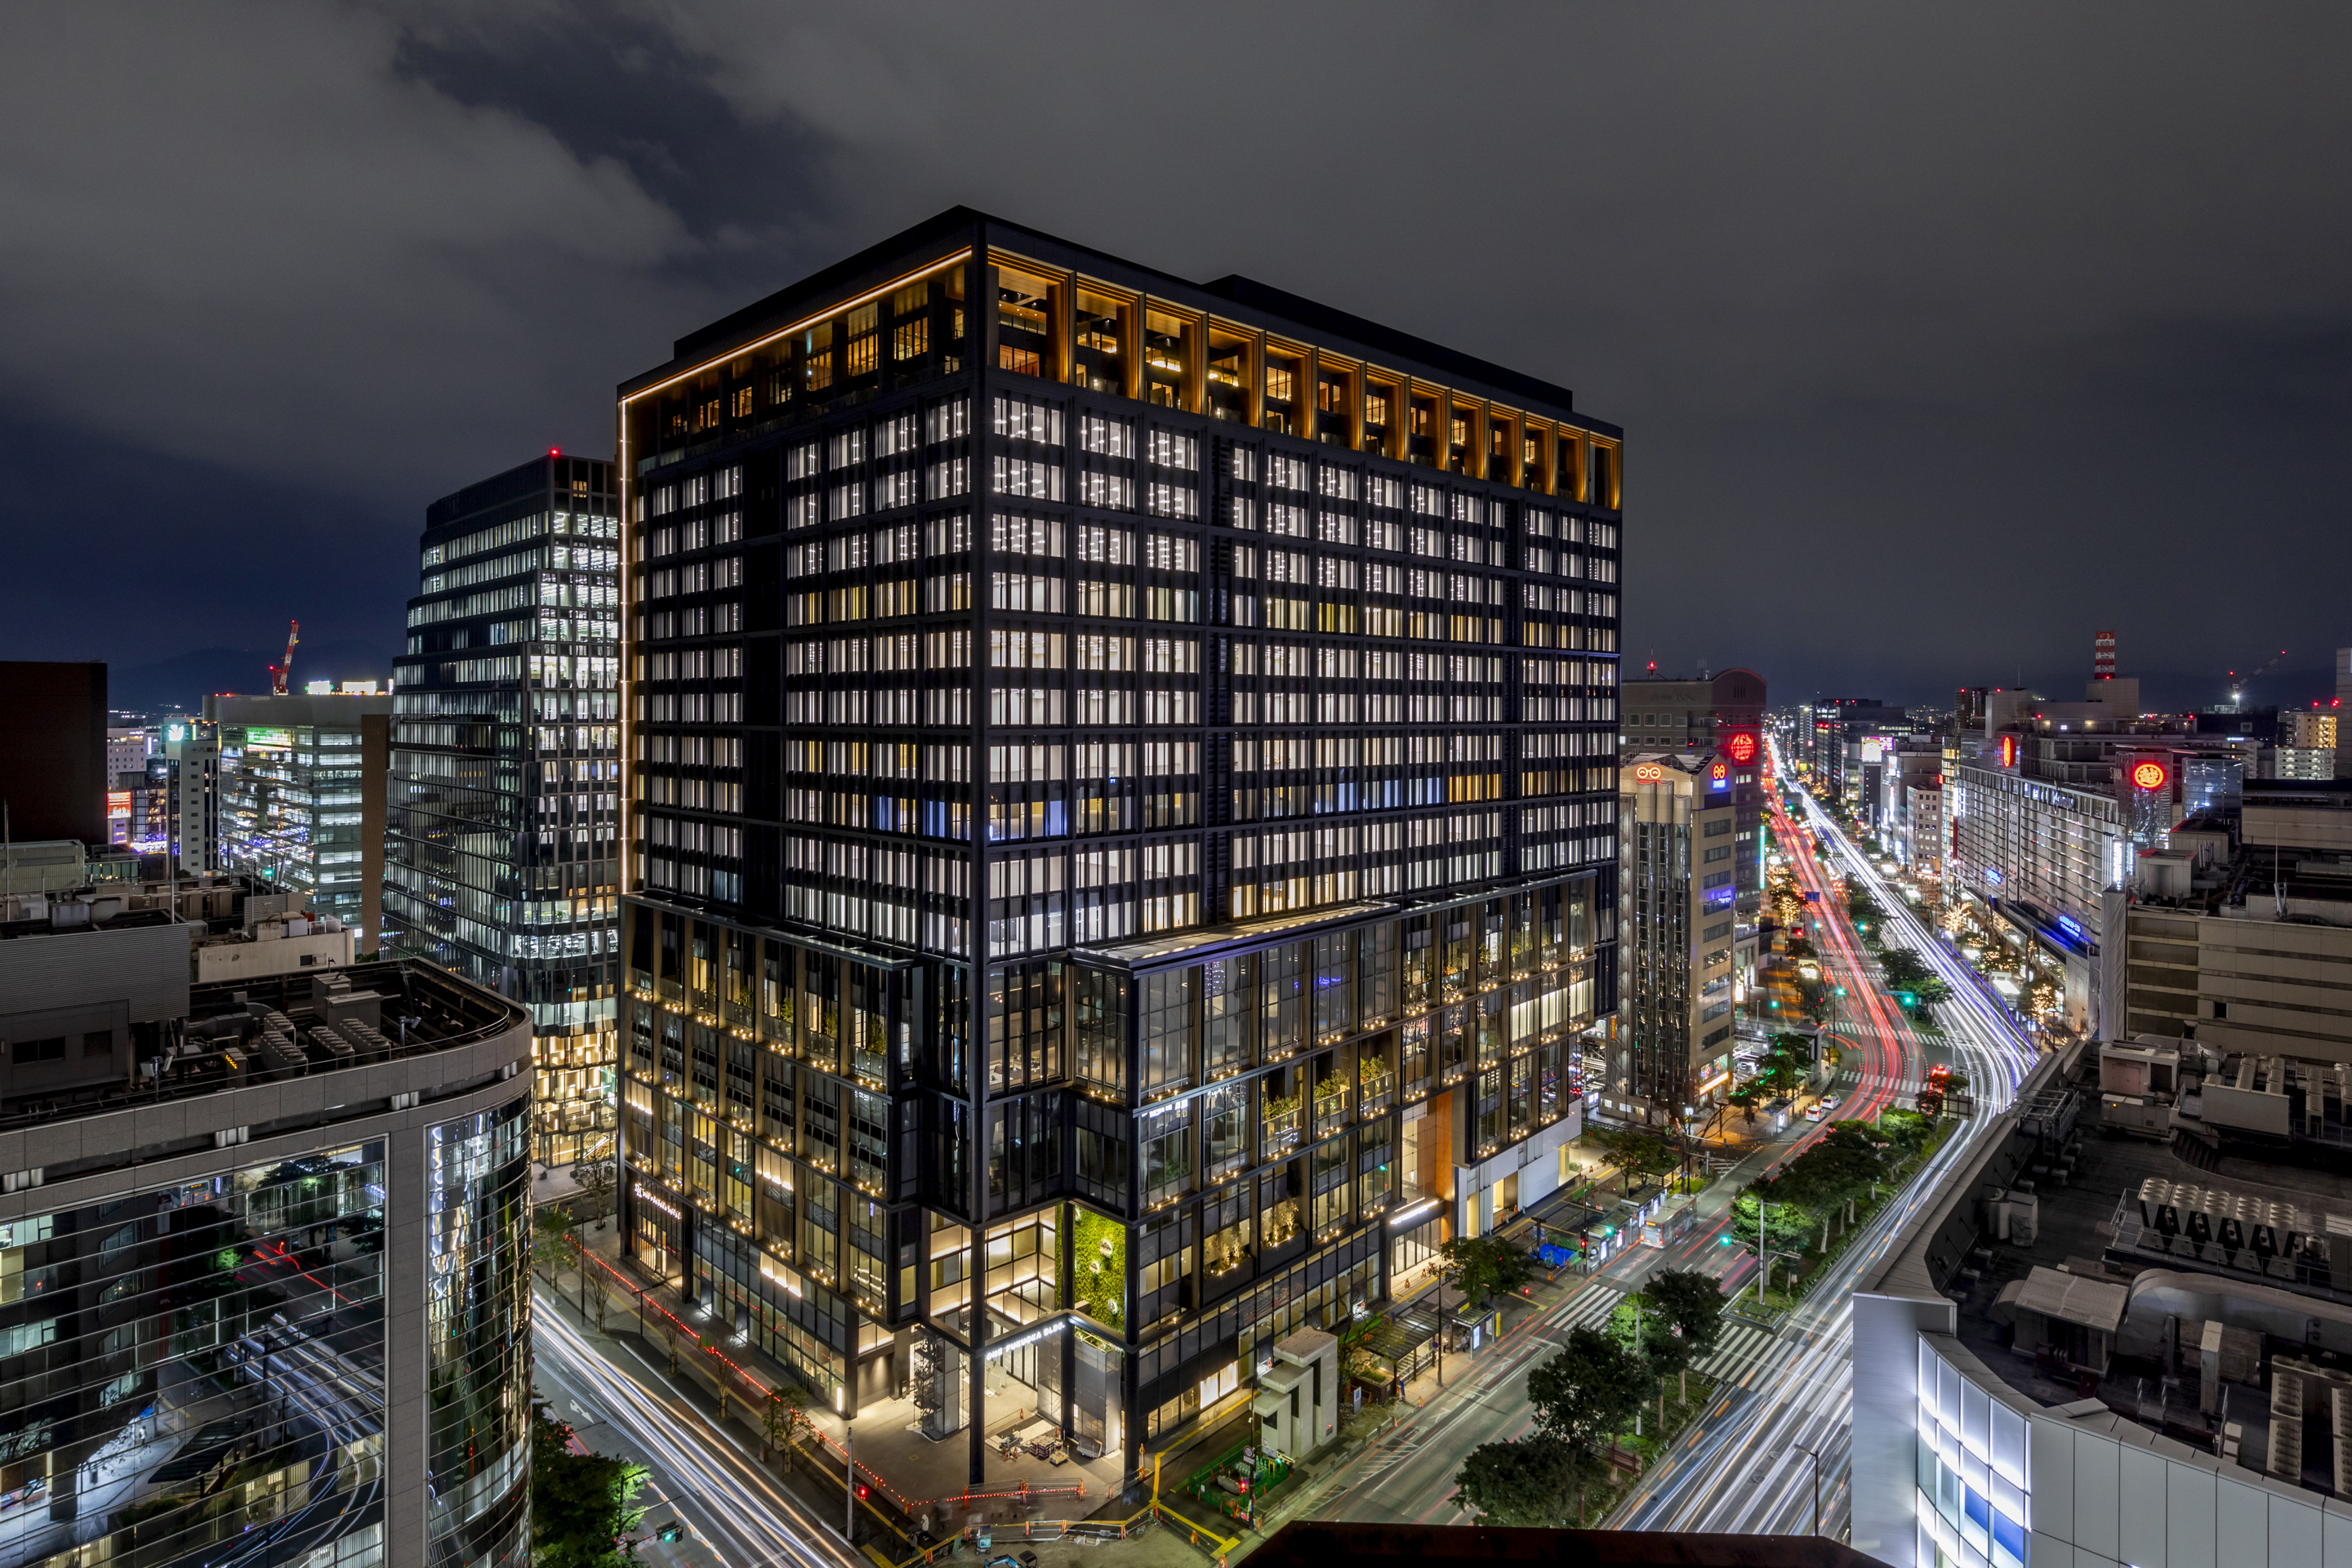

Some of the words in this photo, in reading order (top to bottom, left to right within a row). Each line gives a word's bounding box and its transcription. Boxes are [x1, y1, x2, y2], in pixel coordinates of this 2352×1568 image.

[986, 1348, 1003, 1361] ONE
[1005, 1331, 1042, 1352] FUKUOKA
[1043, 1321, 1066, 1337] BLDG.
